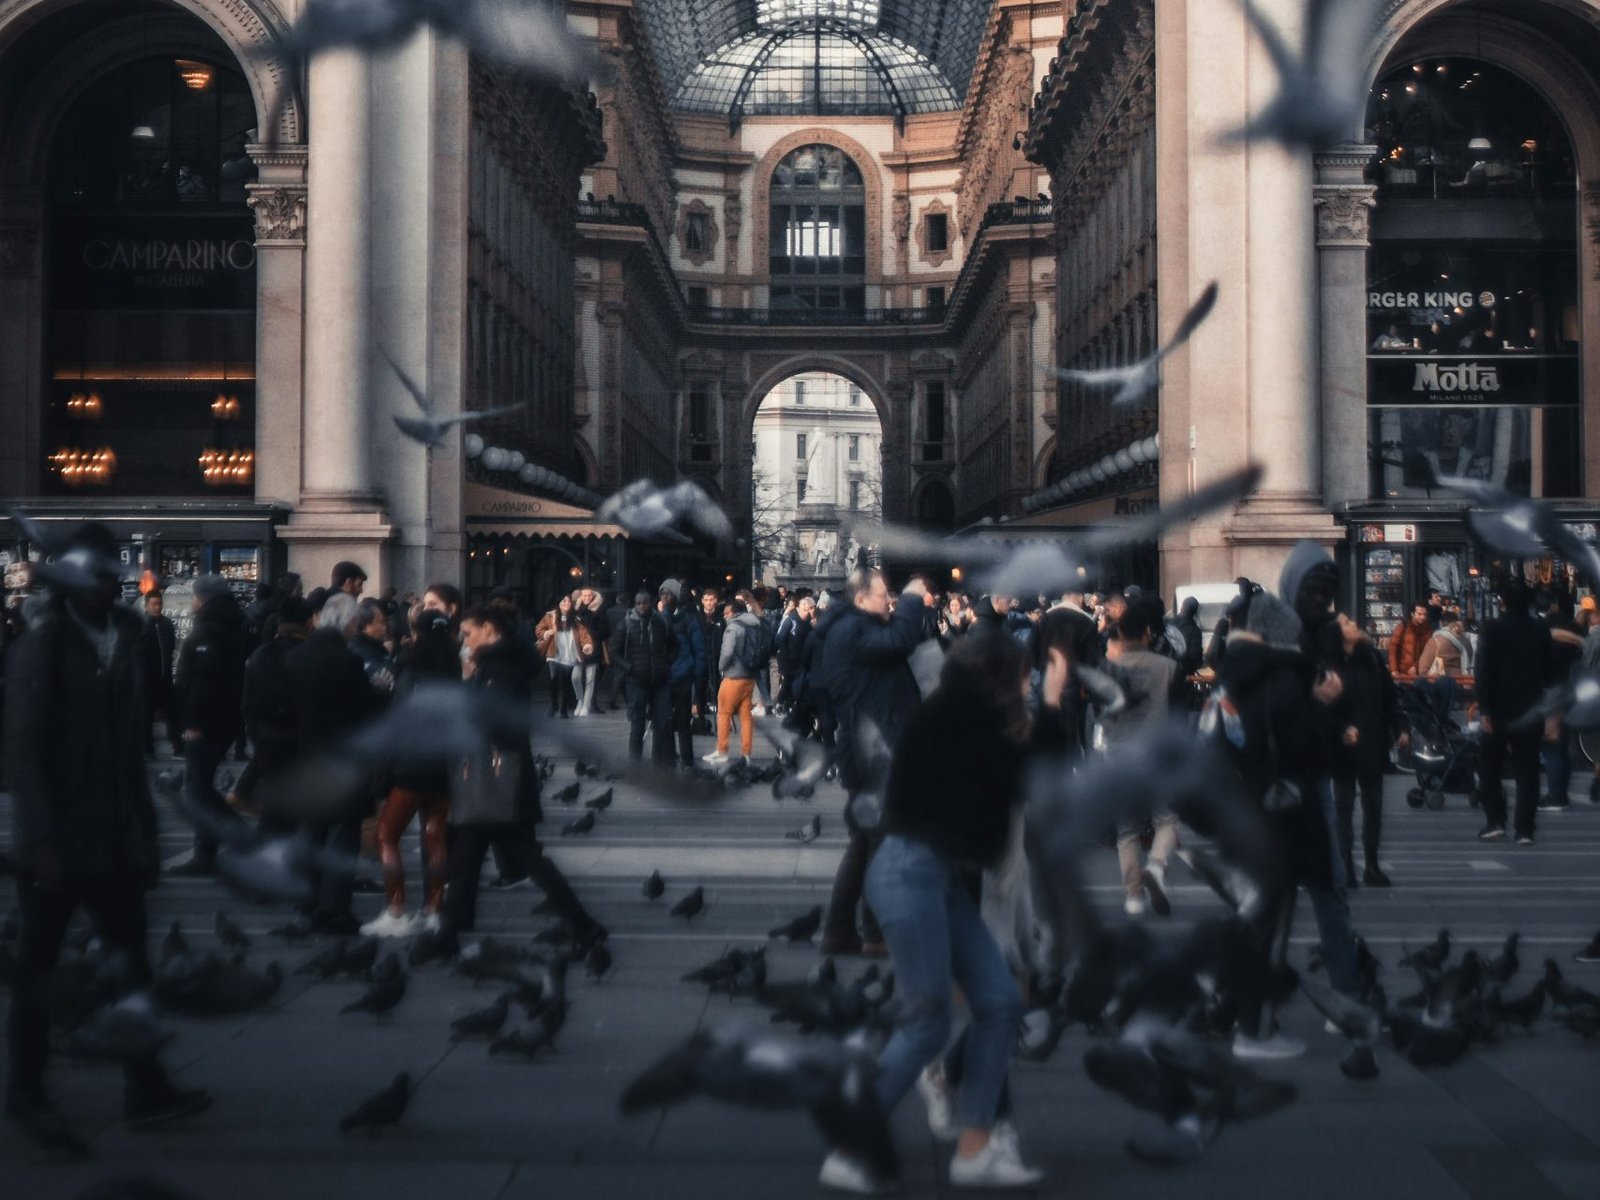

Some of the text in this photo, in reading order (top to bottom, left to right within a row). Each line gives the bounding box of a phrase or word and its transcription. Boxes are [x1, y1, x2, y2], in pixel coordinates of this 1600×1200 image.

[83, 240, 255, 270] CAMPARINO
[1366, 292, 1419, 307] RGER
[1424, 292, 1473, 307] KING
[1412, 362, 1500, 391] Motta
